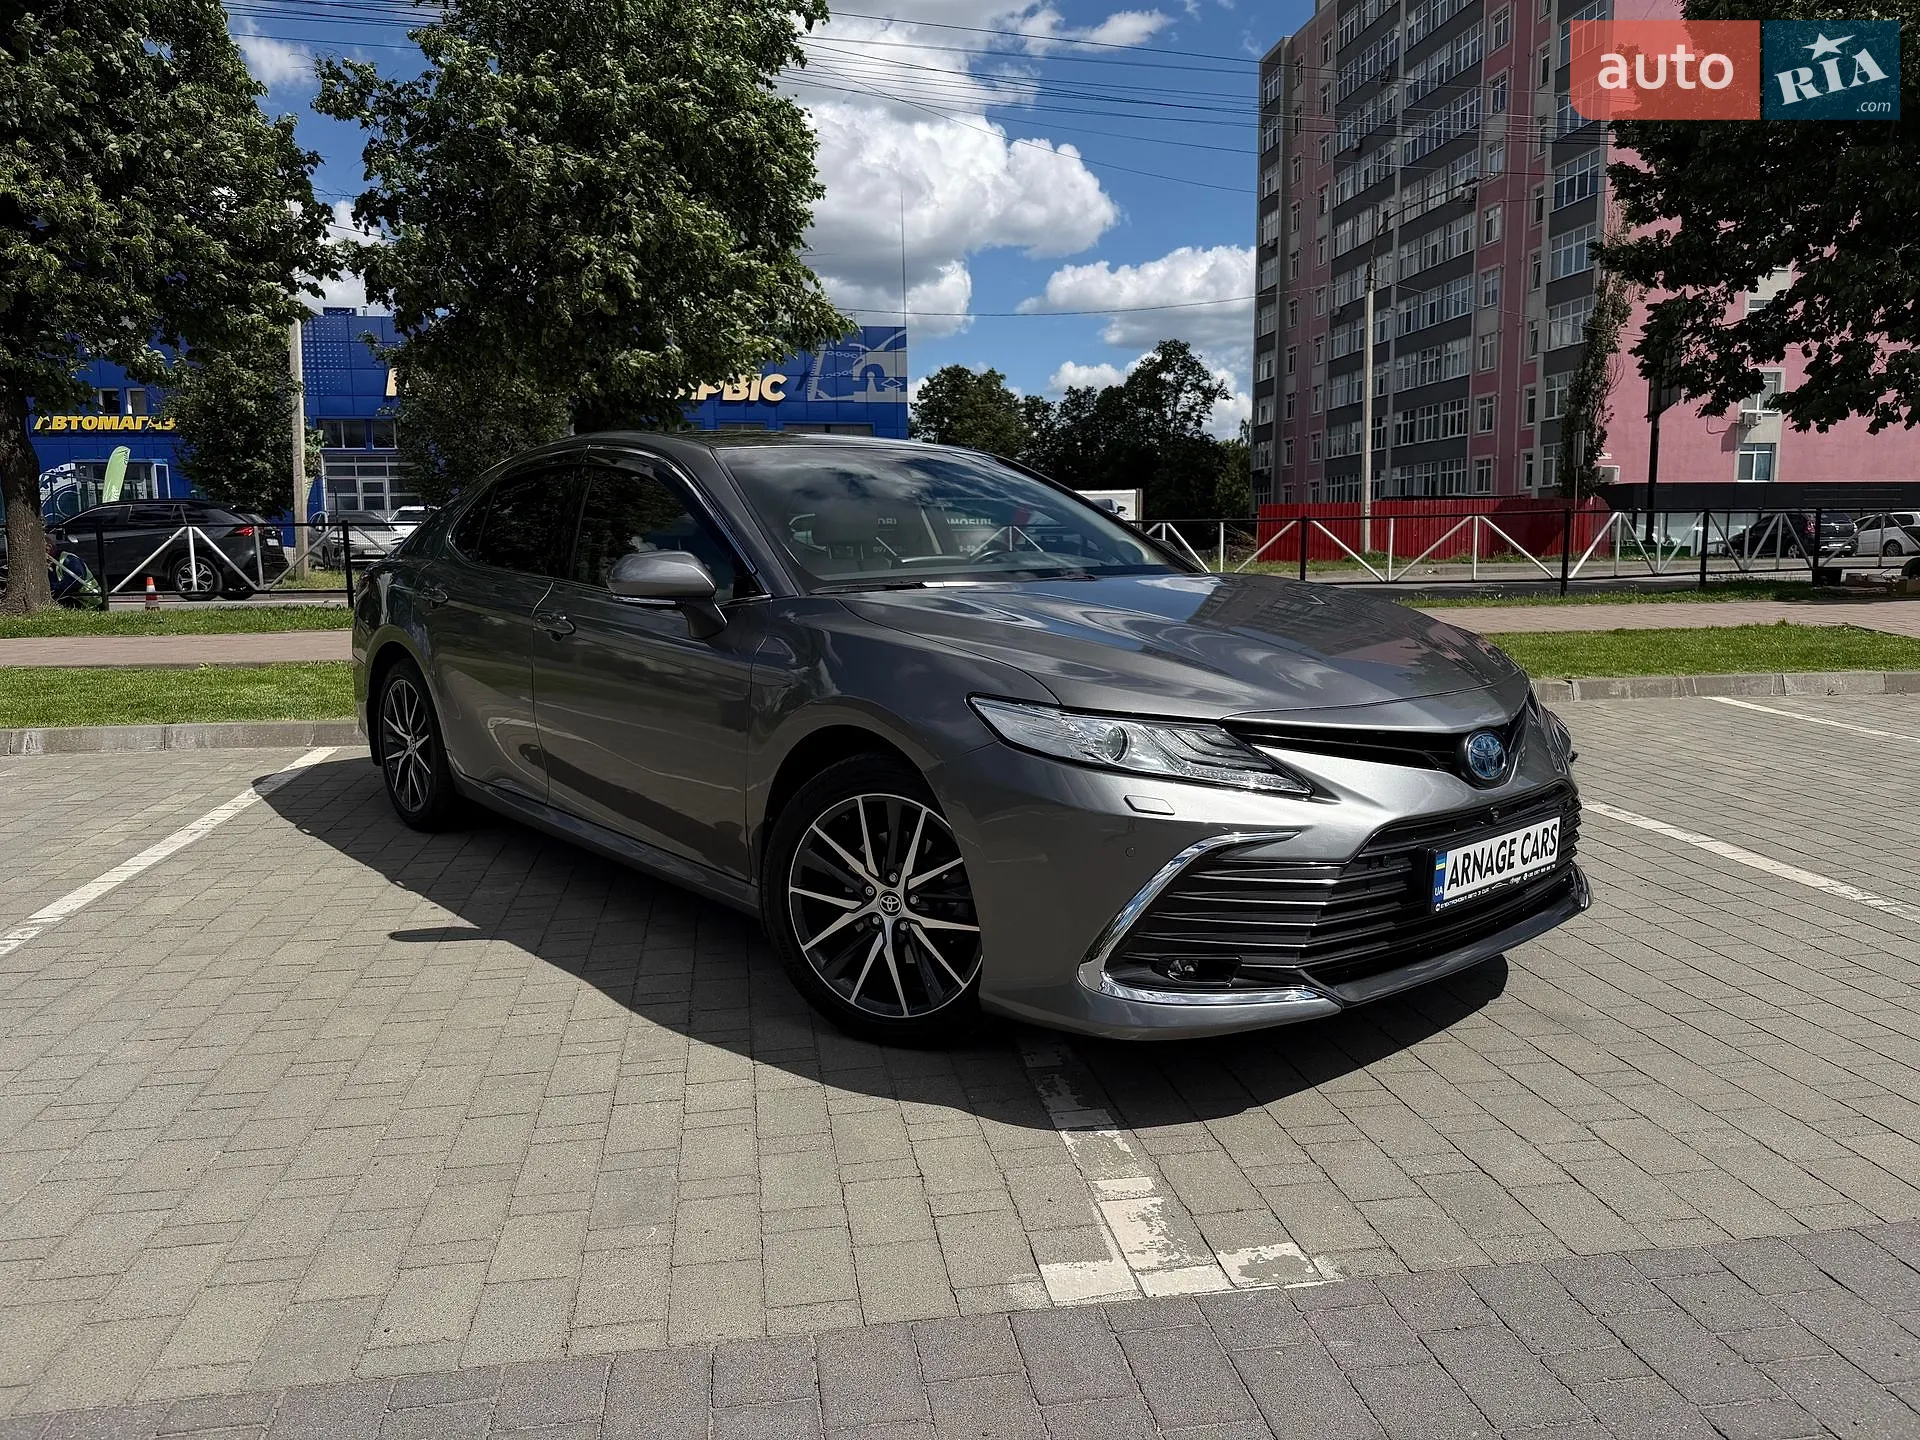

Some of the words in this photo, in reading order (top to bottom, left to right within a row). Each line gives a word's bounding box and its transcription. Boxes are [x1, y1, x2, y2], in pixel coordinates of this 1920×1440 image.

[673, 372, 788, 402] РВІС
[1446, 837, 1517, 892] ARNAGE
[1520, 823, 1558, 866] CARS
[1434, 885, 1443, 896] UA
